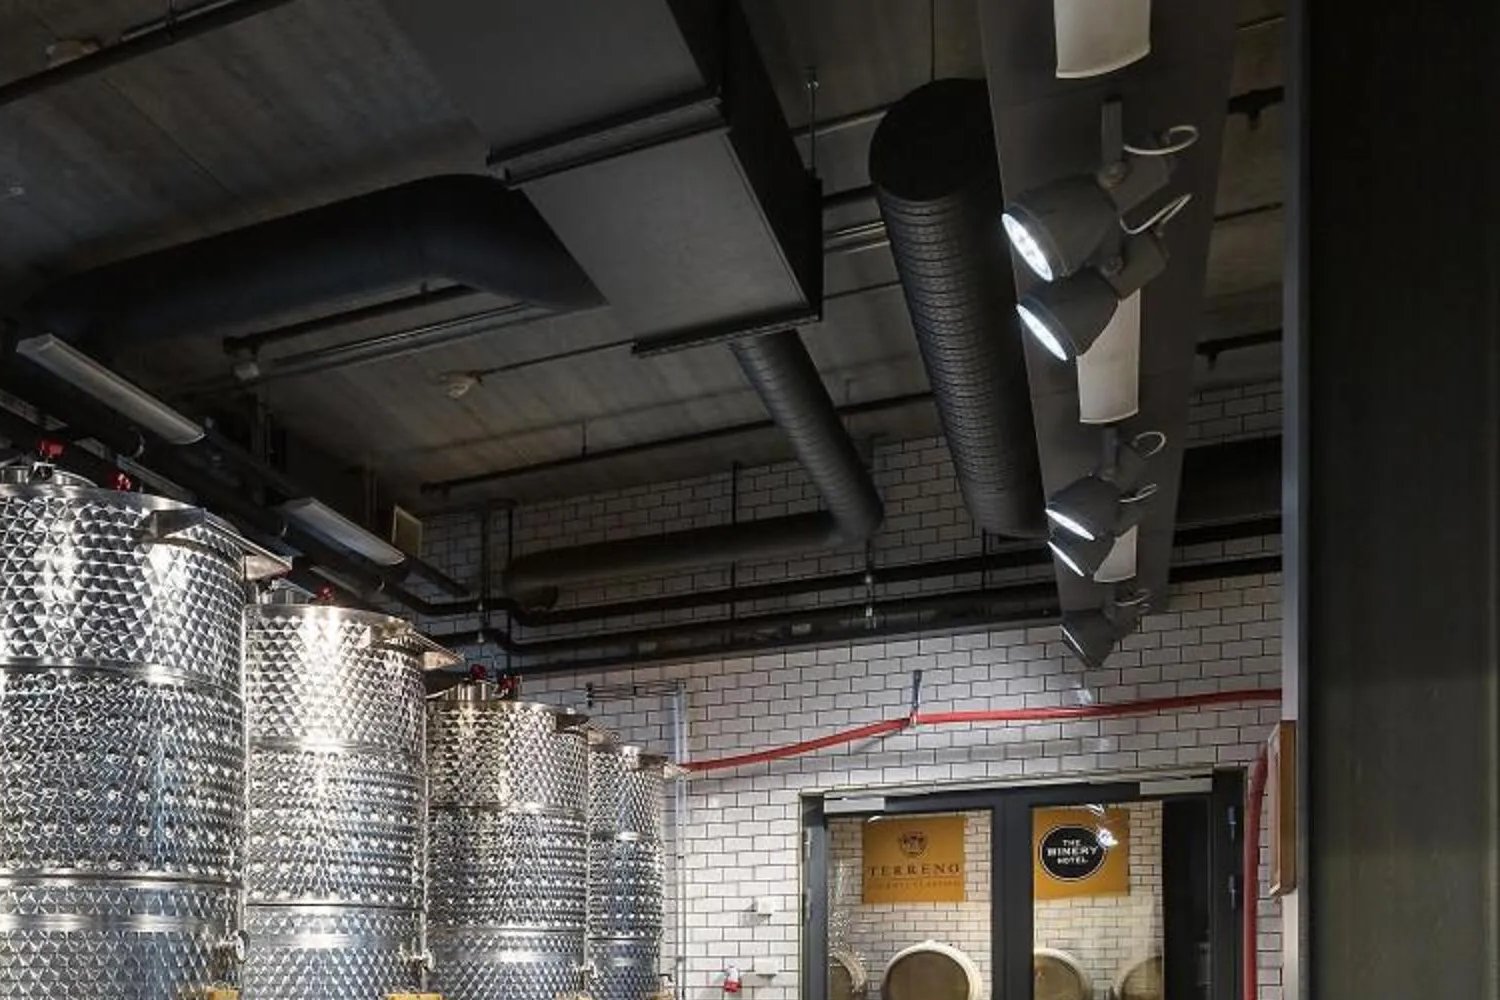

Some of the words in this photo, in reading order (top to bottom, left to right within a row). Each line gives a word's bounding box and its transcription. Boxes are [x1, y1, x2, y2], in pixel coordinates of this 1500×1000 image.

[1062, 839, 1081, 847] THE
[1047, 846, 1098, 857] WINERY
[1057, 856, 1088, 865] HOTEL
[866, 863, 960, 877] TERRENO
